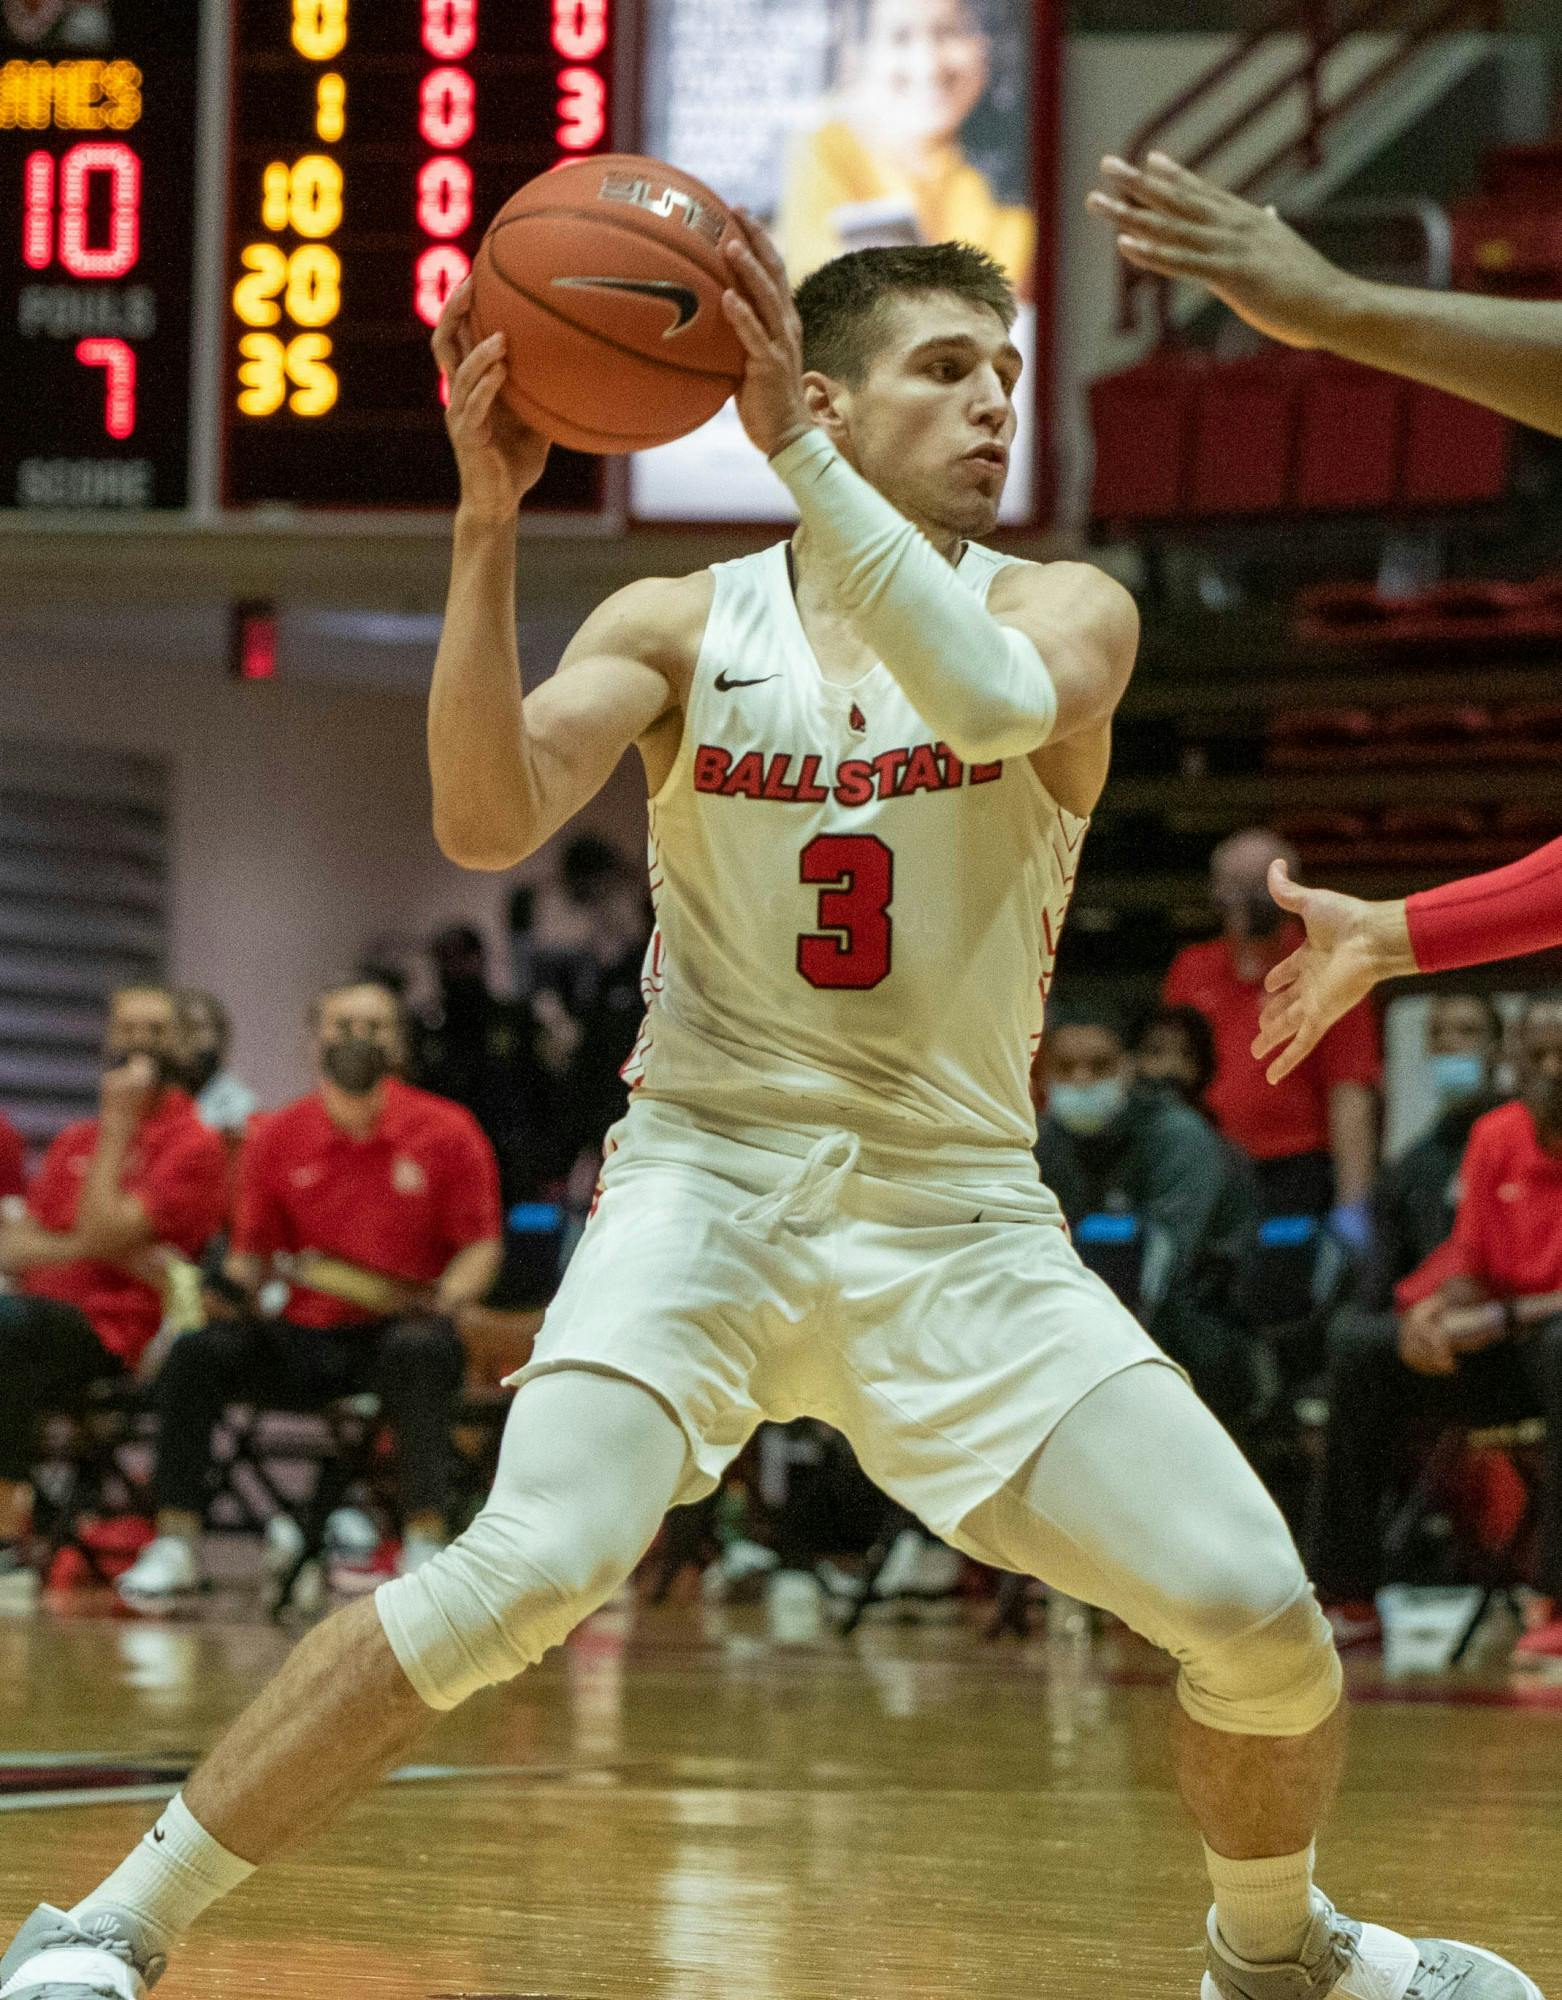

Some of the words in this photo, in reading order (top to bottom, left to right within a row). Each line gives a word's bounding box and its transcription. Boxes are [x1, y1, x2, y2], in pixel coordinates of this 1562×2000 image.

[418, 66, 476, 148] 0
[556, 66, 605, 150] 3
[23, 142, 141, 278] 10
[262, 154, 343, 239] 10
[416, 155, 473, 239] 0
[232, 242, 341, 328] 20
[76, 337, 136, 439] 7
[237, 332, 338, 417] 35
[693, 744, 830, 803] BALL
[796, 834, 894, 990] 3
